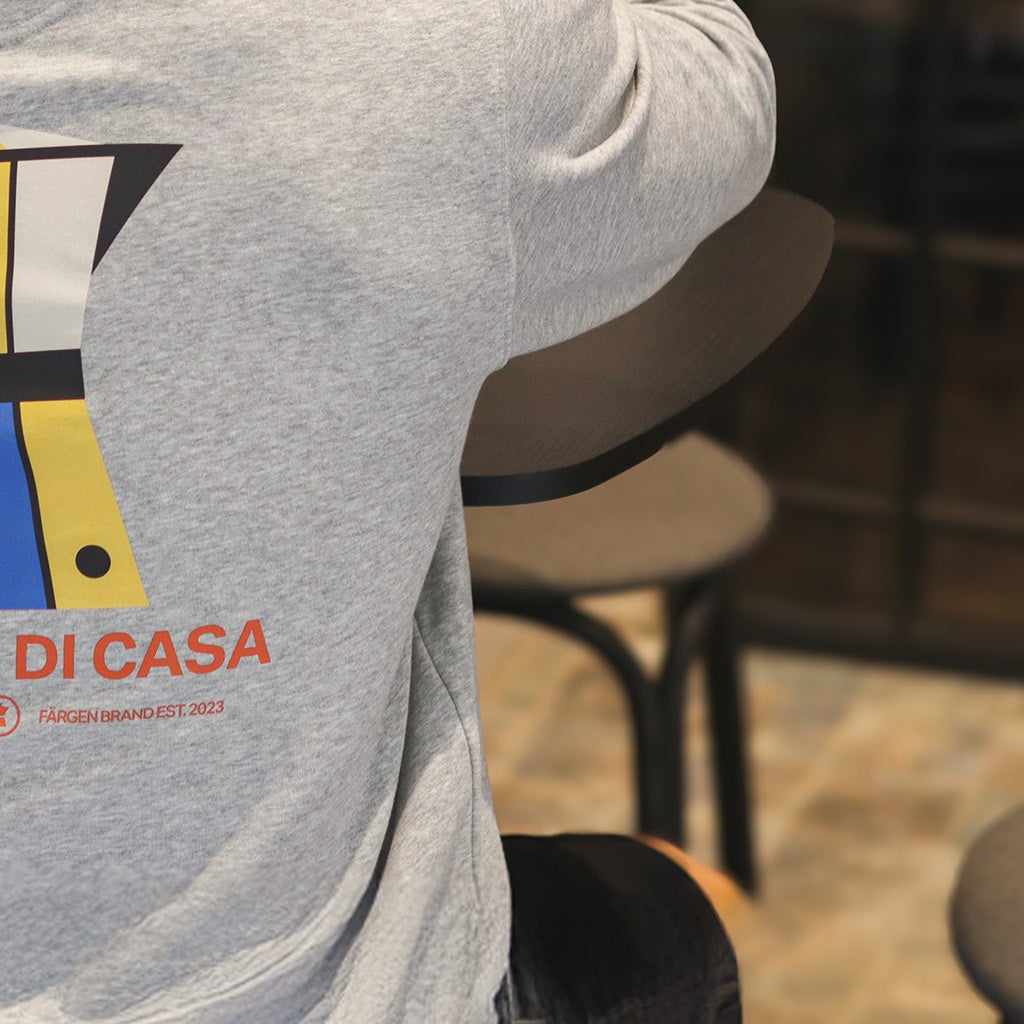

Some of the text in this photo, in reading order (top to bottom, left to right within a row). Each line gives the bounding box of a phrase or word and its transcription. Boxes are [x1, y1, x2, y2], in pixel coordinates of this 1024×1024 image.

[15, 633, 76, 681] DI
[92, 618, 272, 681] CASA
[38, 700, 225, 724] FÄRGEN BRAND EST. 2023
